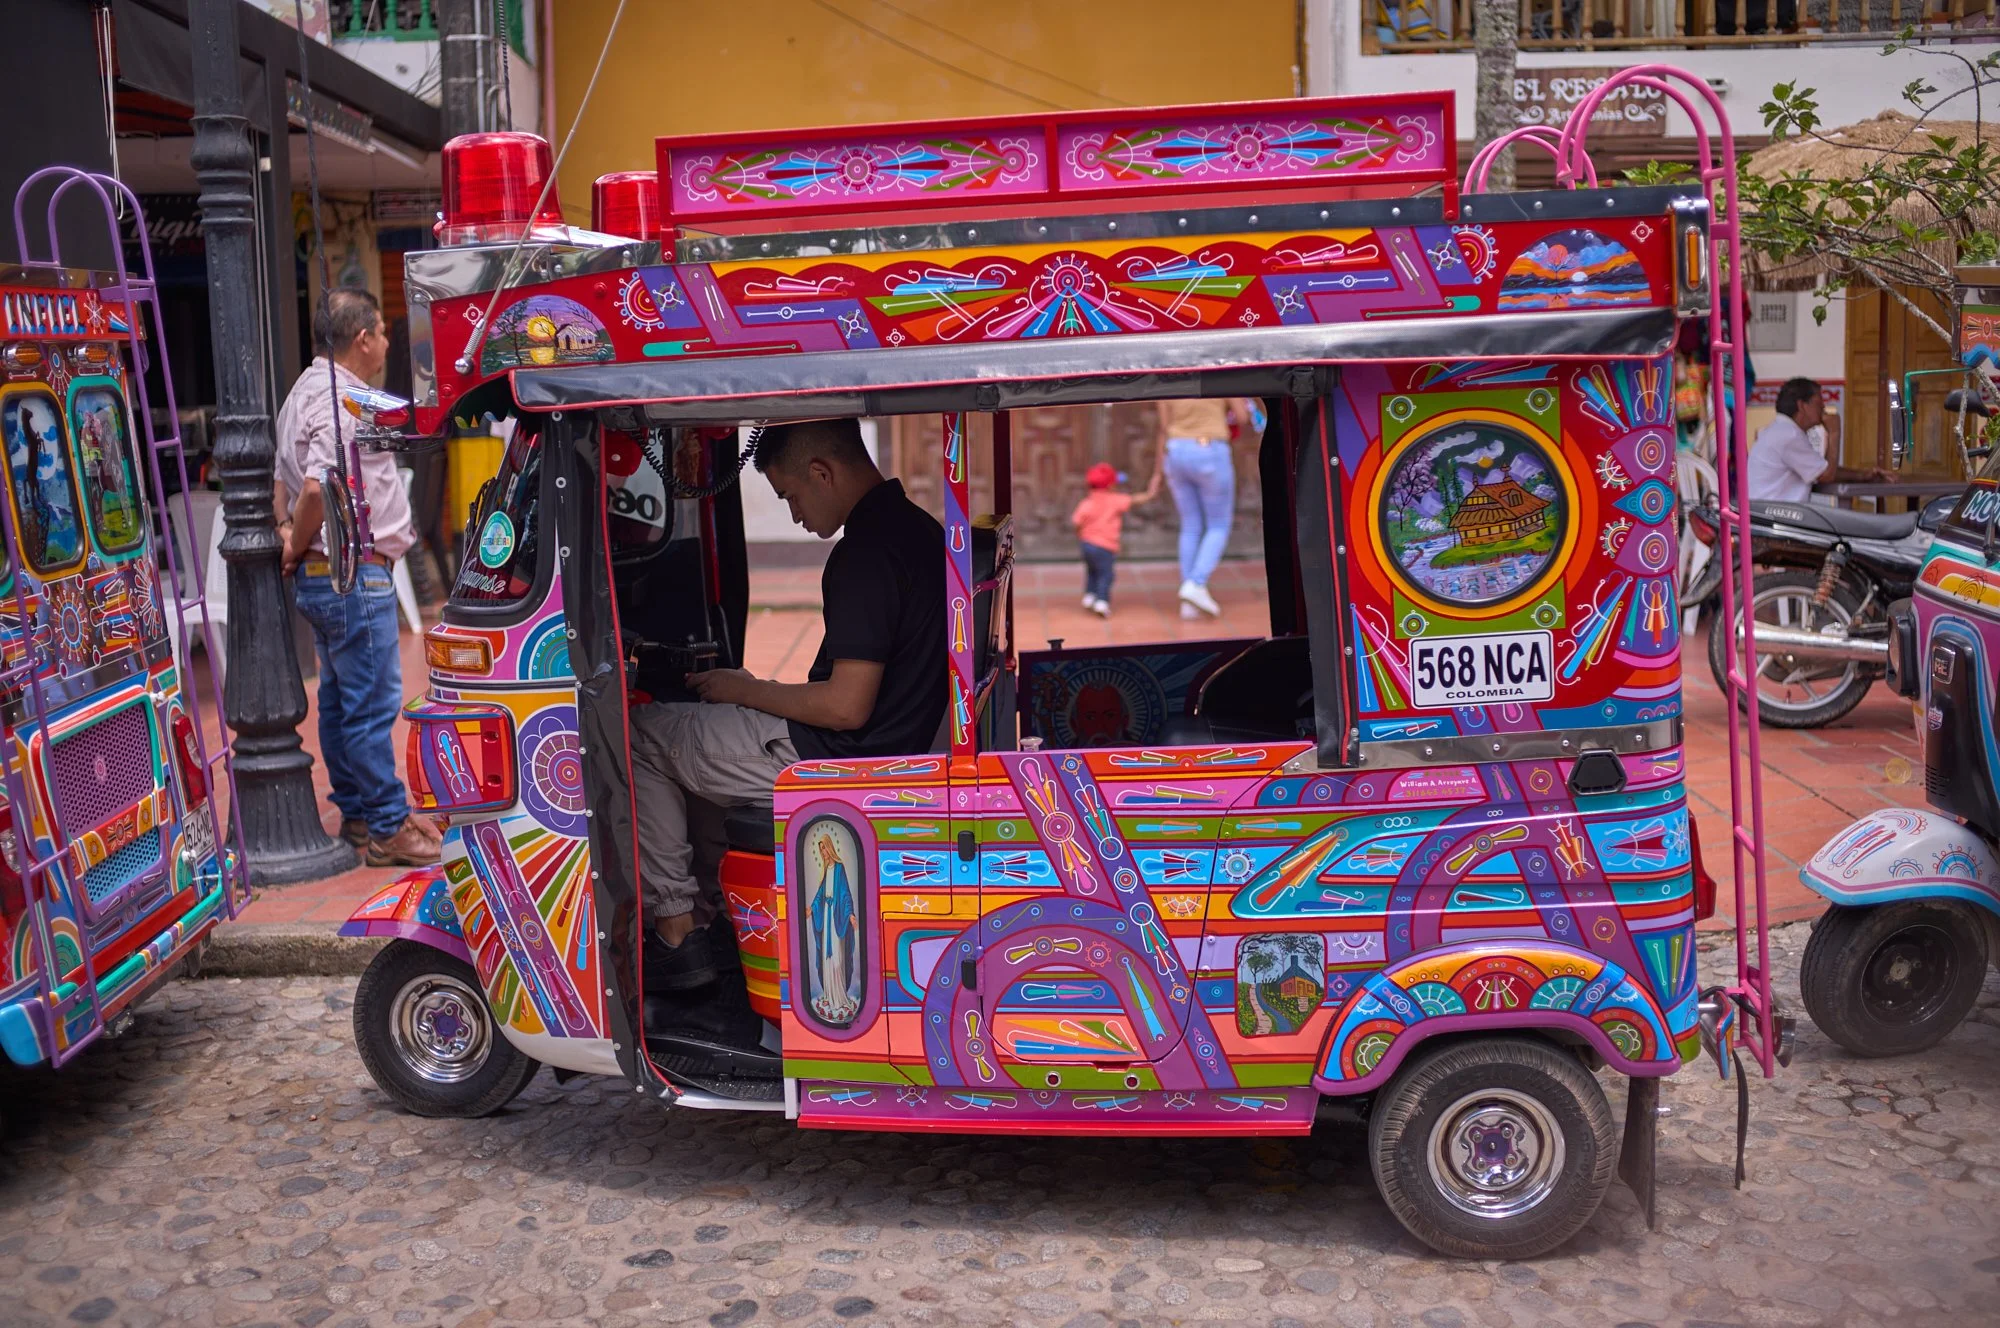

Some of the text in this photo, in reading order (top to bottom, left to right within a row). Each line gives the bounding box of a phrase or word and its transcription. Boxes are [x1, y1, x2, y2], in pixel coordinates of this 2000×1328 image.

[1513, 78, 1546, 102] EL
[1418, 641, 1547, 690] 568 NCA
[1446, 687, 1525, 699] COLOMBIA
